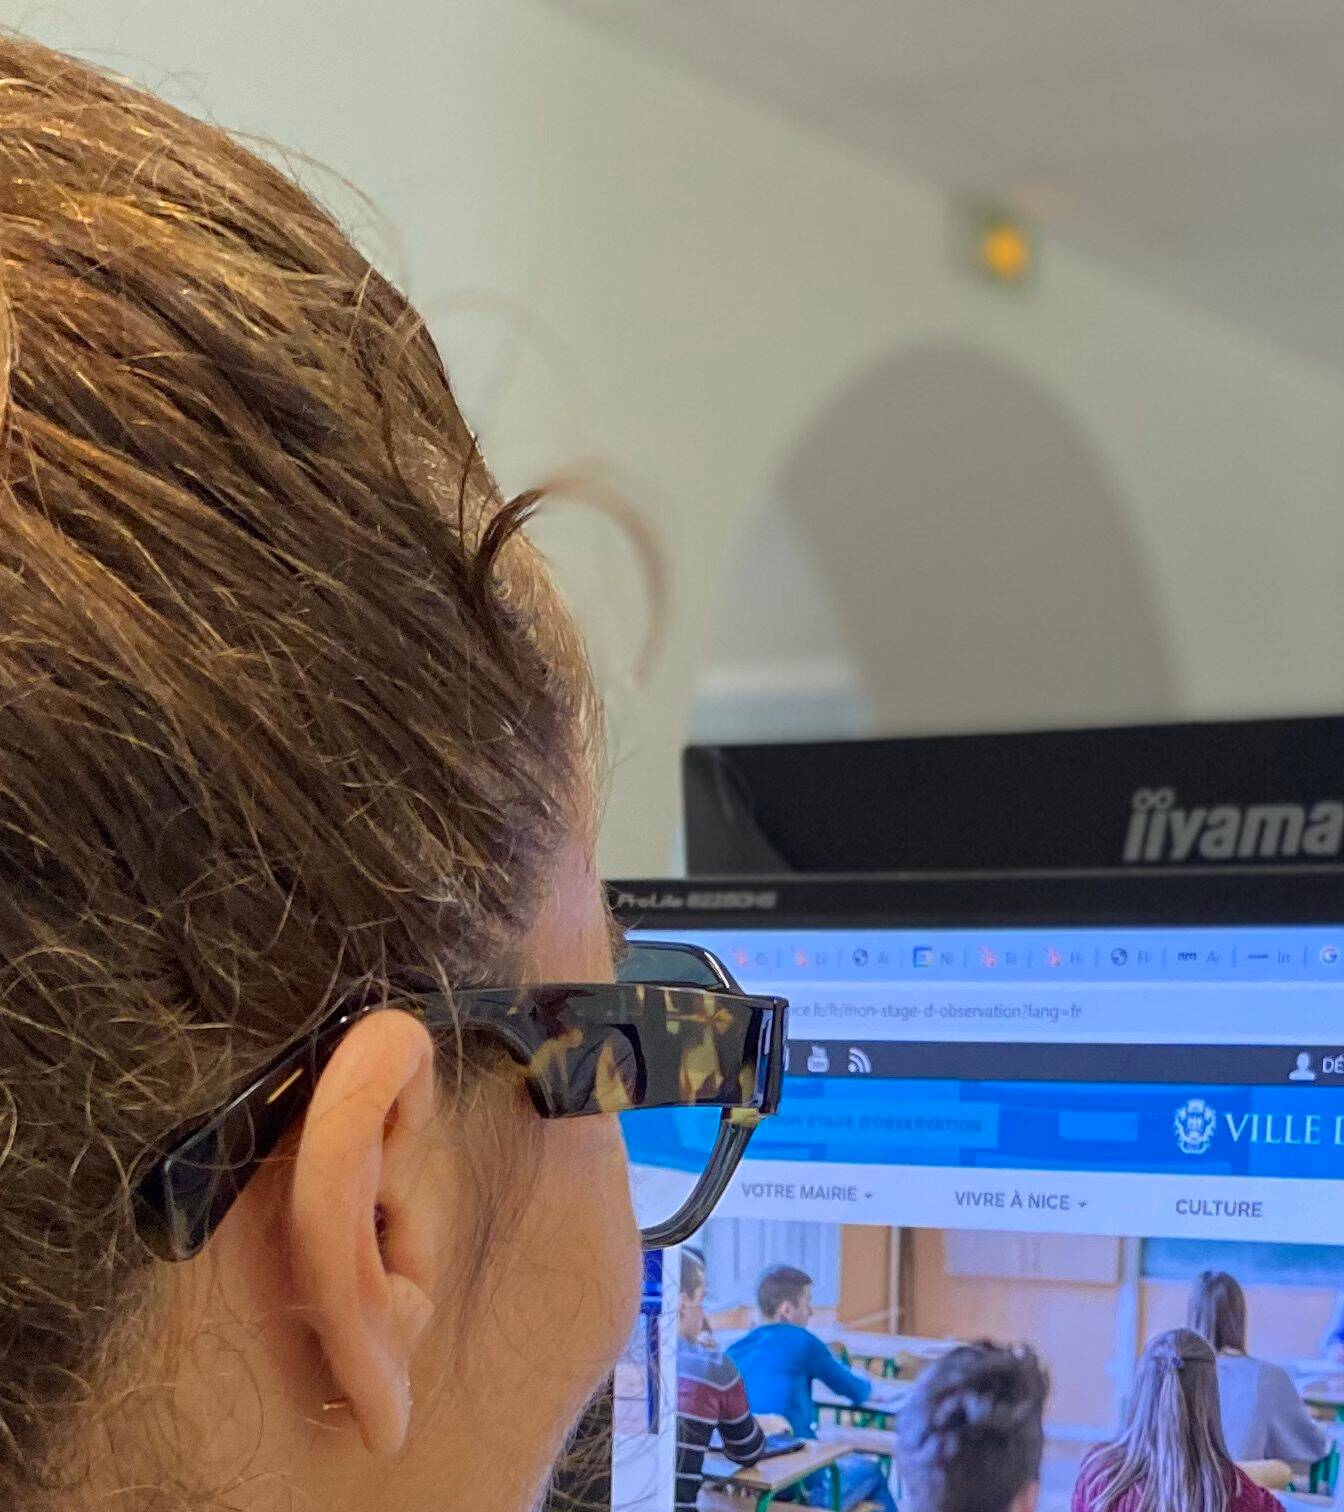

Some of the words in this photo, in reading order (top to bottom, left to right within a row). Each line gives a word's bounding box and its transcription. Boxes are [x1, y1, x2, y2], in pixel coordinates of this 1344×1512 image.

[1225, 1112, 1321, 1146] VILLE
[742, 1182, 796, 1200] VOTRE
[799, 1184, 857, 1202] MAIRIE
[955, 1190, 1005, 1208] VIVRE
[1010, 1189, 1023, 1209] À
[1026, 1193, 1071, 1211] NICE
[1175, 1198, 1263, 1219] CULTURE
